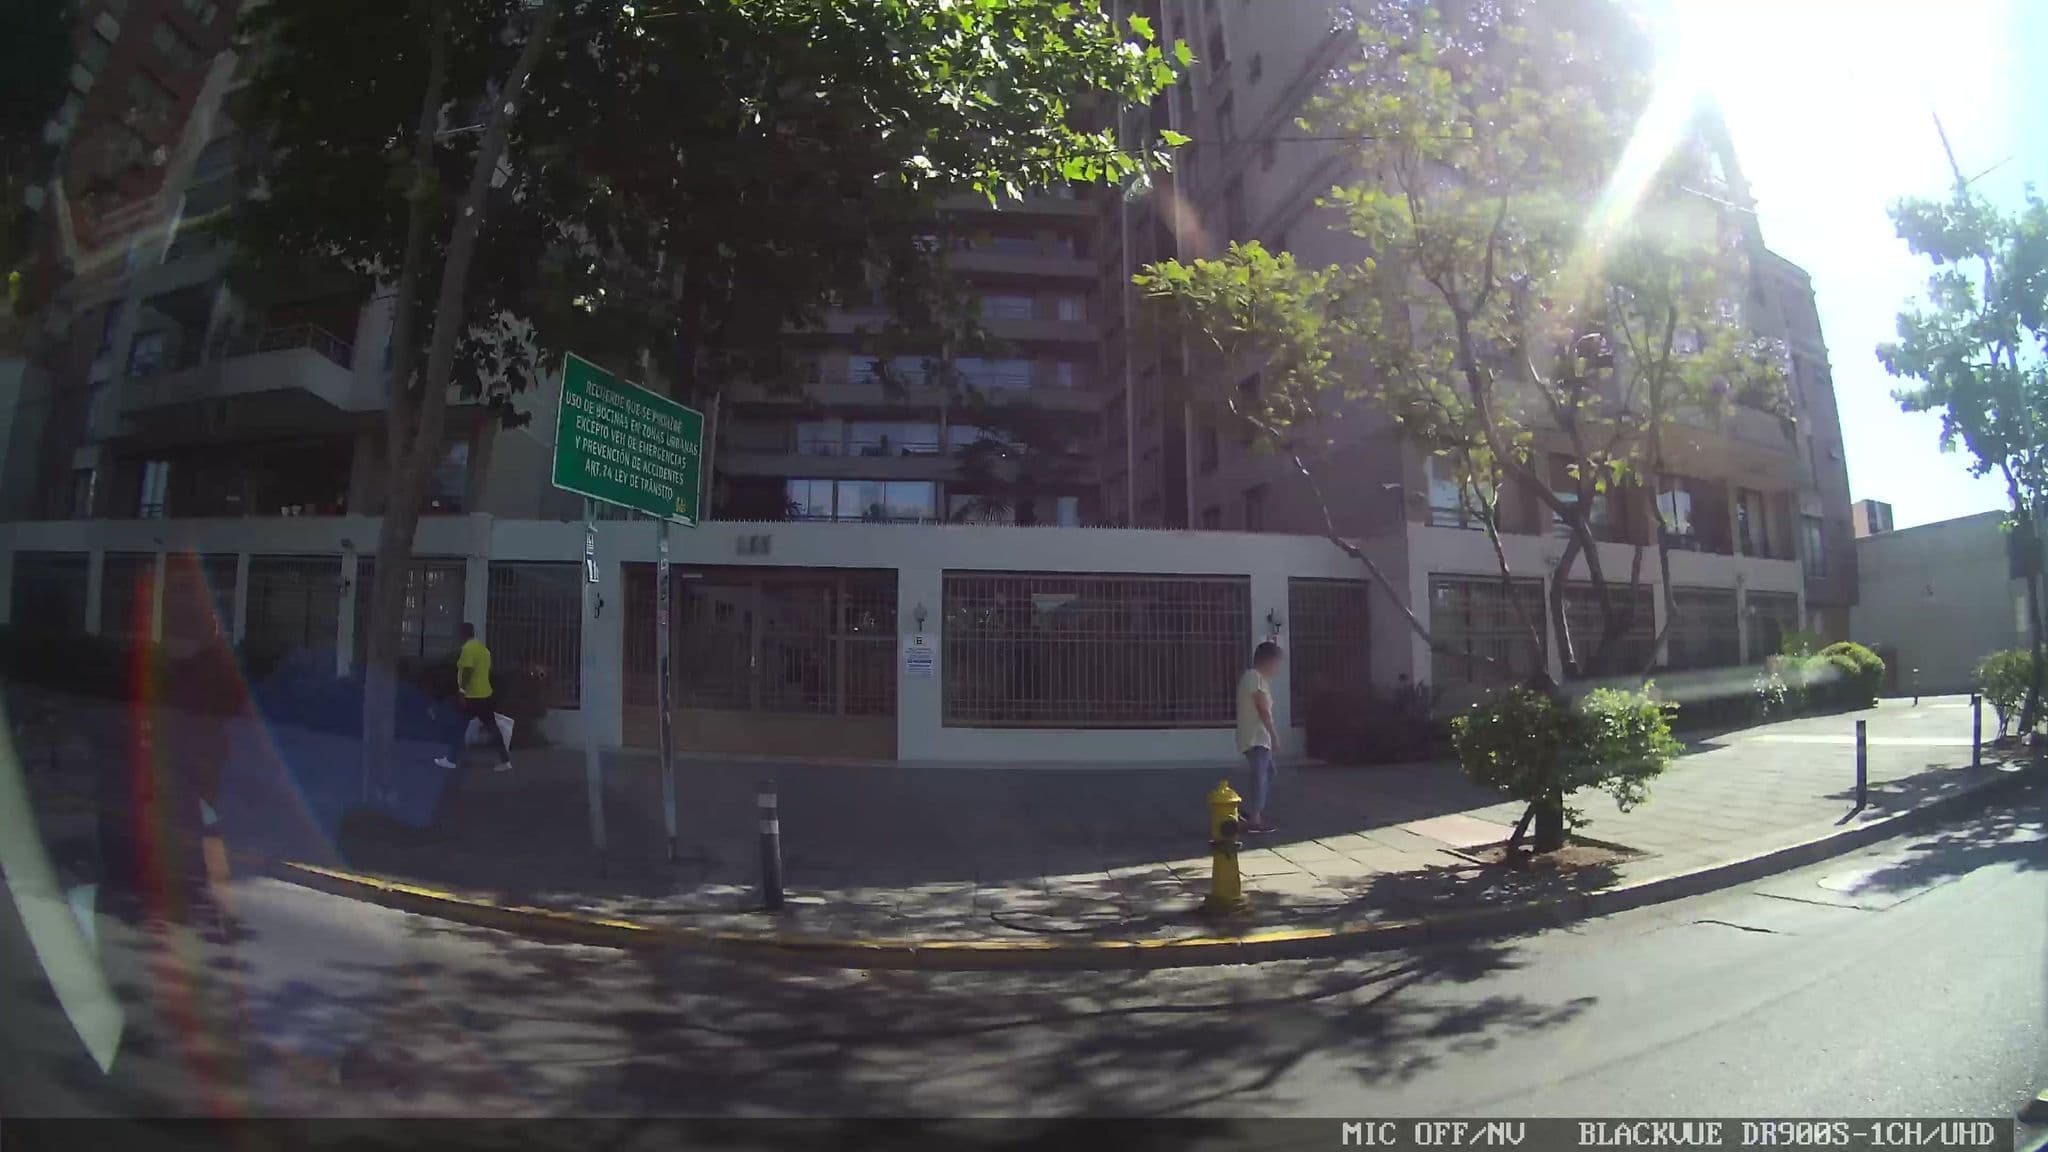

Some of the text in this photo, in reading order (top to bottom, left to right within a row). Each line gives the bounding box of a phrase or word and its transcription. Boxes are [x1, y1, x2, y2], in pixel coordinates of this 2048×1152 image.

[566, 391, 698, 456] USO DE BOCINAS EN ZONAS URBANAS
[586, 381, 625, 409] RECUERDE
[625, 398, 641, 416] QUE
[642, 403, 651, 420] SE
[575, 436, 684, 485] Y PREVENCIÓN DE ACCIDENTES
[576, 416, 609, 438] EXCEPTO
[628, 435, 637, 450] DE
[639, 440, 687, 469] EMERGENCIAS
[615, 470, 627, 484] LEY
[629, 475, 640, 489] DE
[640, 477, 673, 500] TRÁNSITO
